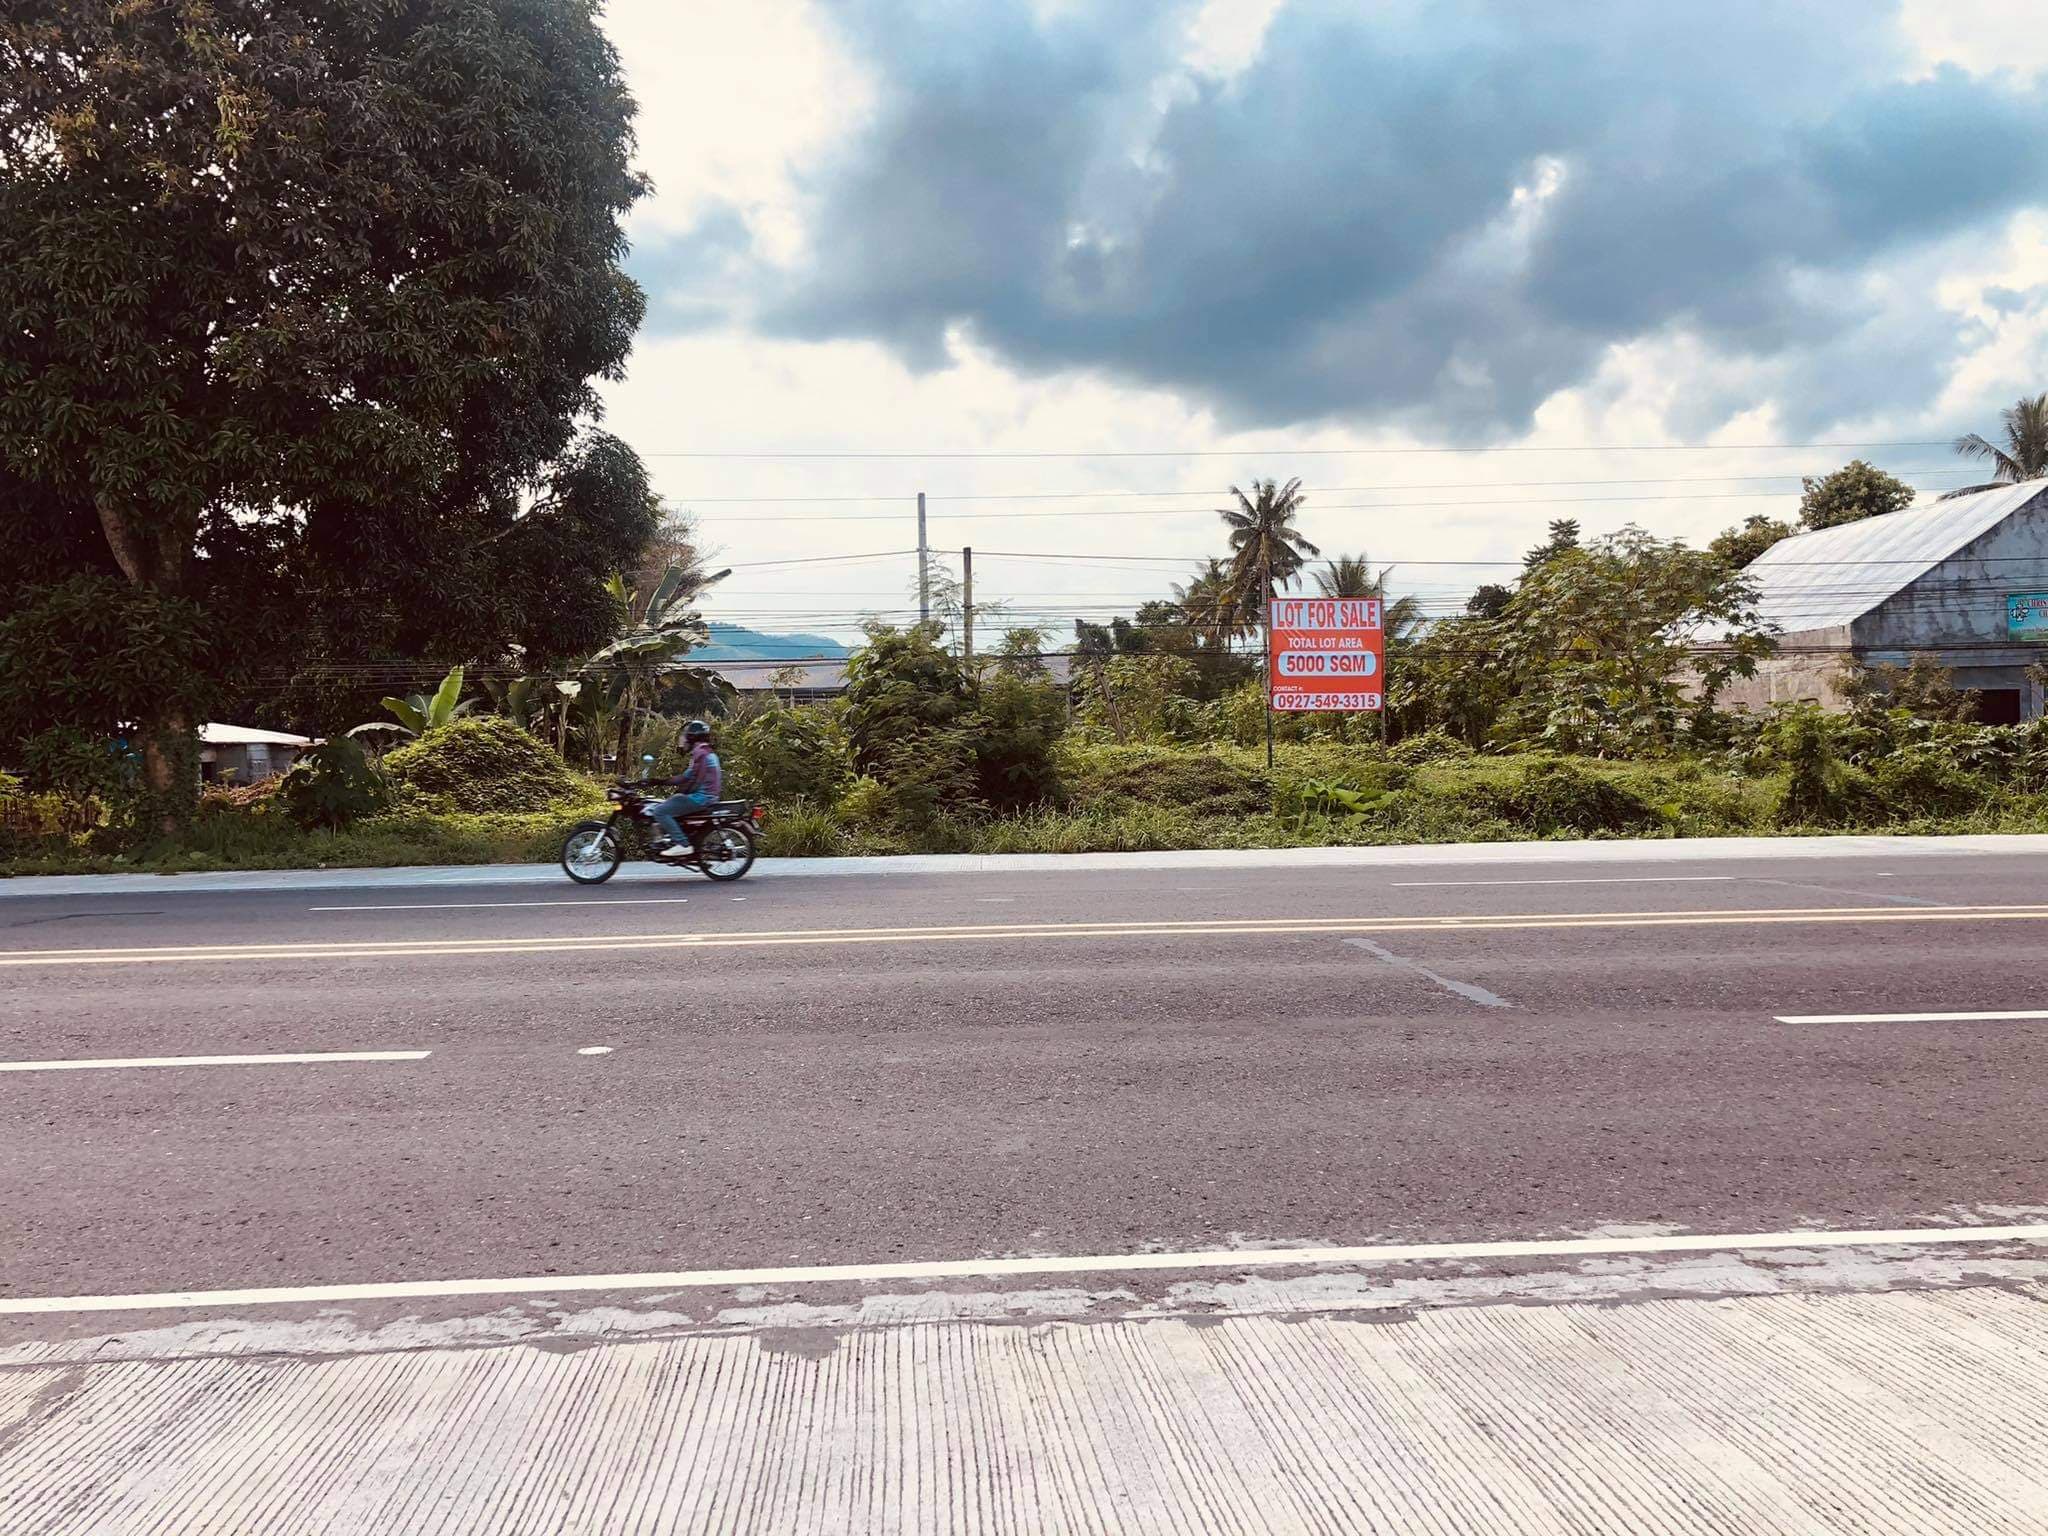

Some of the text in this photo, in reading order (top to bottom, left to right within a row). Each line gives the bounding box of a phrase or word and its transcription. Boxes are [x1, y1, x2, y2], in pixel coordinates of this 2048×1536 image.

[1277, 603, 1376, 627] LOT FOR SALE
[1289, 638, 1363, 648] TOTAL LOT AREA
[1287, 655, 1366, 672] 5000 SQM
[1278, 694, 1376, 708] 0927-549-3315
